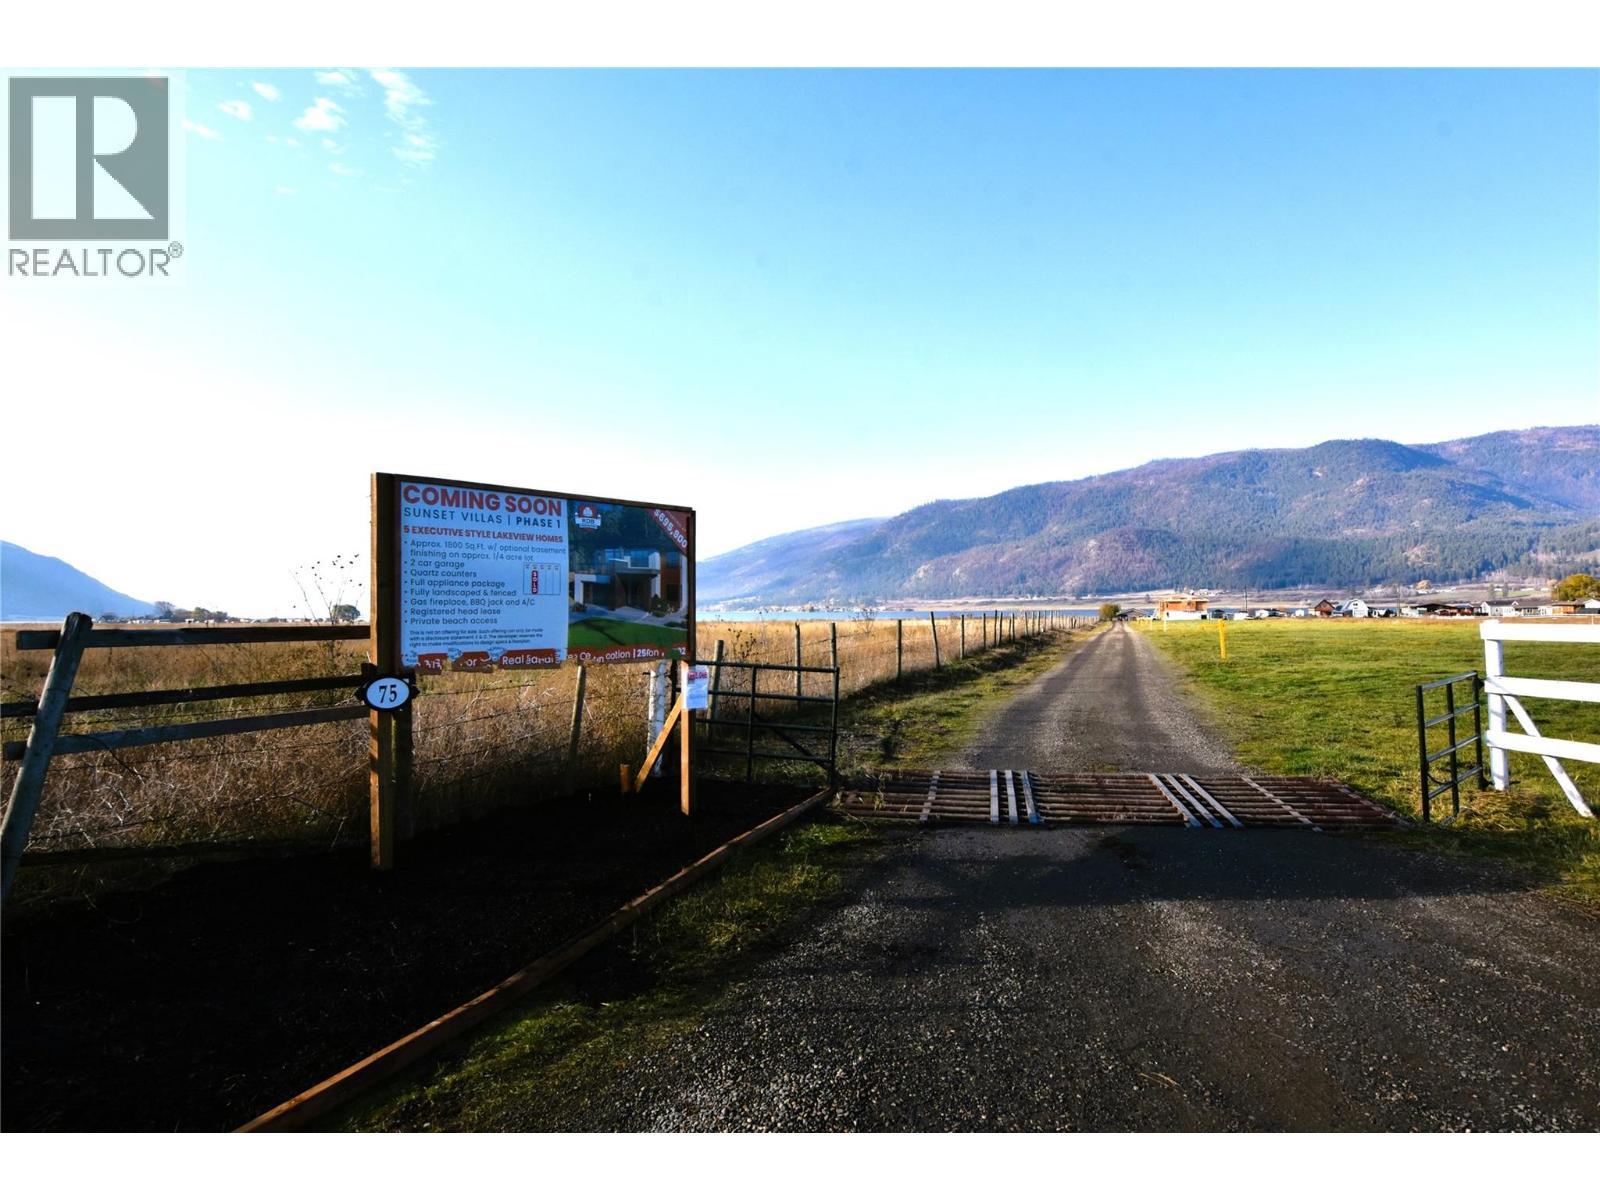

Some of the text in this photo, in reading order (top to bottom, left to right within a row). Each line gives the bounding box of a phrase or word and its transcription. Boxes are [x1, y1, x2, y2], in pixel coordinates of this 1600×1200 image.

[403, 484, 562, 517] COMING SOON
[404, 507, 455, 521] SUNSET
[461, 512, 503, 524] VILLAS
[516, 518, 553, 528] PHASE
[556, 519, 561, 529] 1
[411, 526, 464, 537] EXECUTIVE
[465, 529, 491, 538] STYLE
[492, 531, 535, 541] LAKEVIEW
[535, 535, 563, 543] HOMES
[410, 548, 447, 560] finishing
[499, 545, 529, 554] optional
[531, 545, 566, 554] basement
[417, 559, 433, 567] car
[434, 561, 465, 570] garage
[410, 569, 477, 578] Quartz counters
[410, 578, 506, 589] Full appliance package
[410, 588, 431, 598] Fully
[432, 588, 481, 598] landscaped
[490, 589, 517, 597] fenced
[410, 598, 428, 606] Gas
[470, 598, 486, 606] BBQ
[487, 598, 503, 607] jack
[505, 598, 520, 606] and
[521, 598, 535, 606] A/C
[410, 607, 501, 617] Registered head lease
[410, 616, 441, 625] Private
[442, 616, 469, 625] beach
[378, 684, 397, 704] 75
